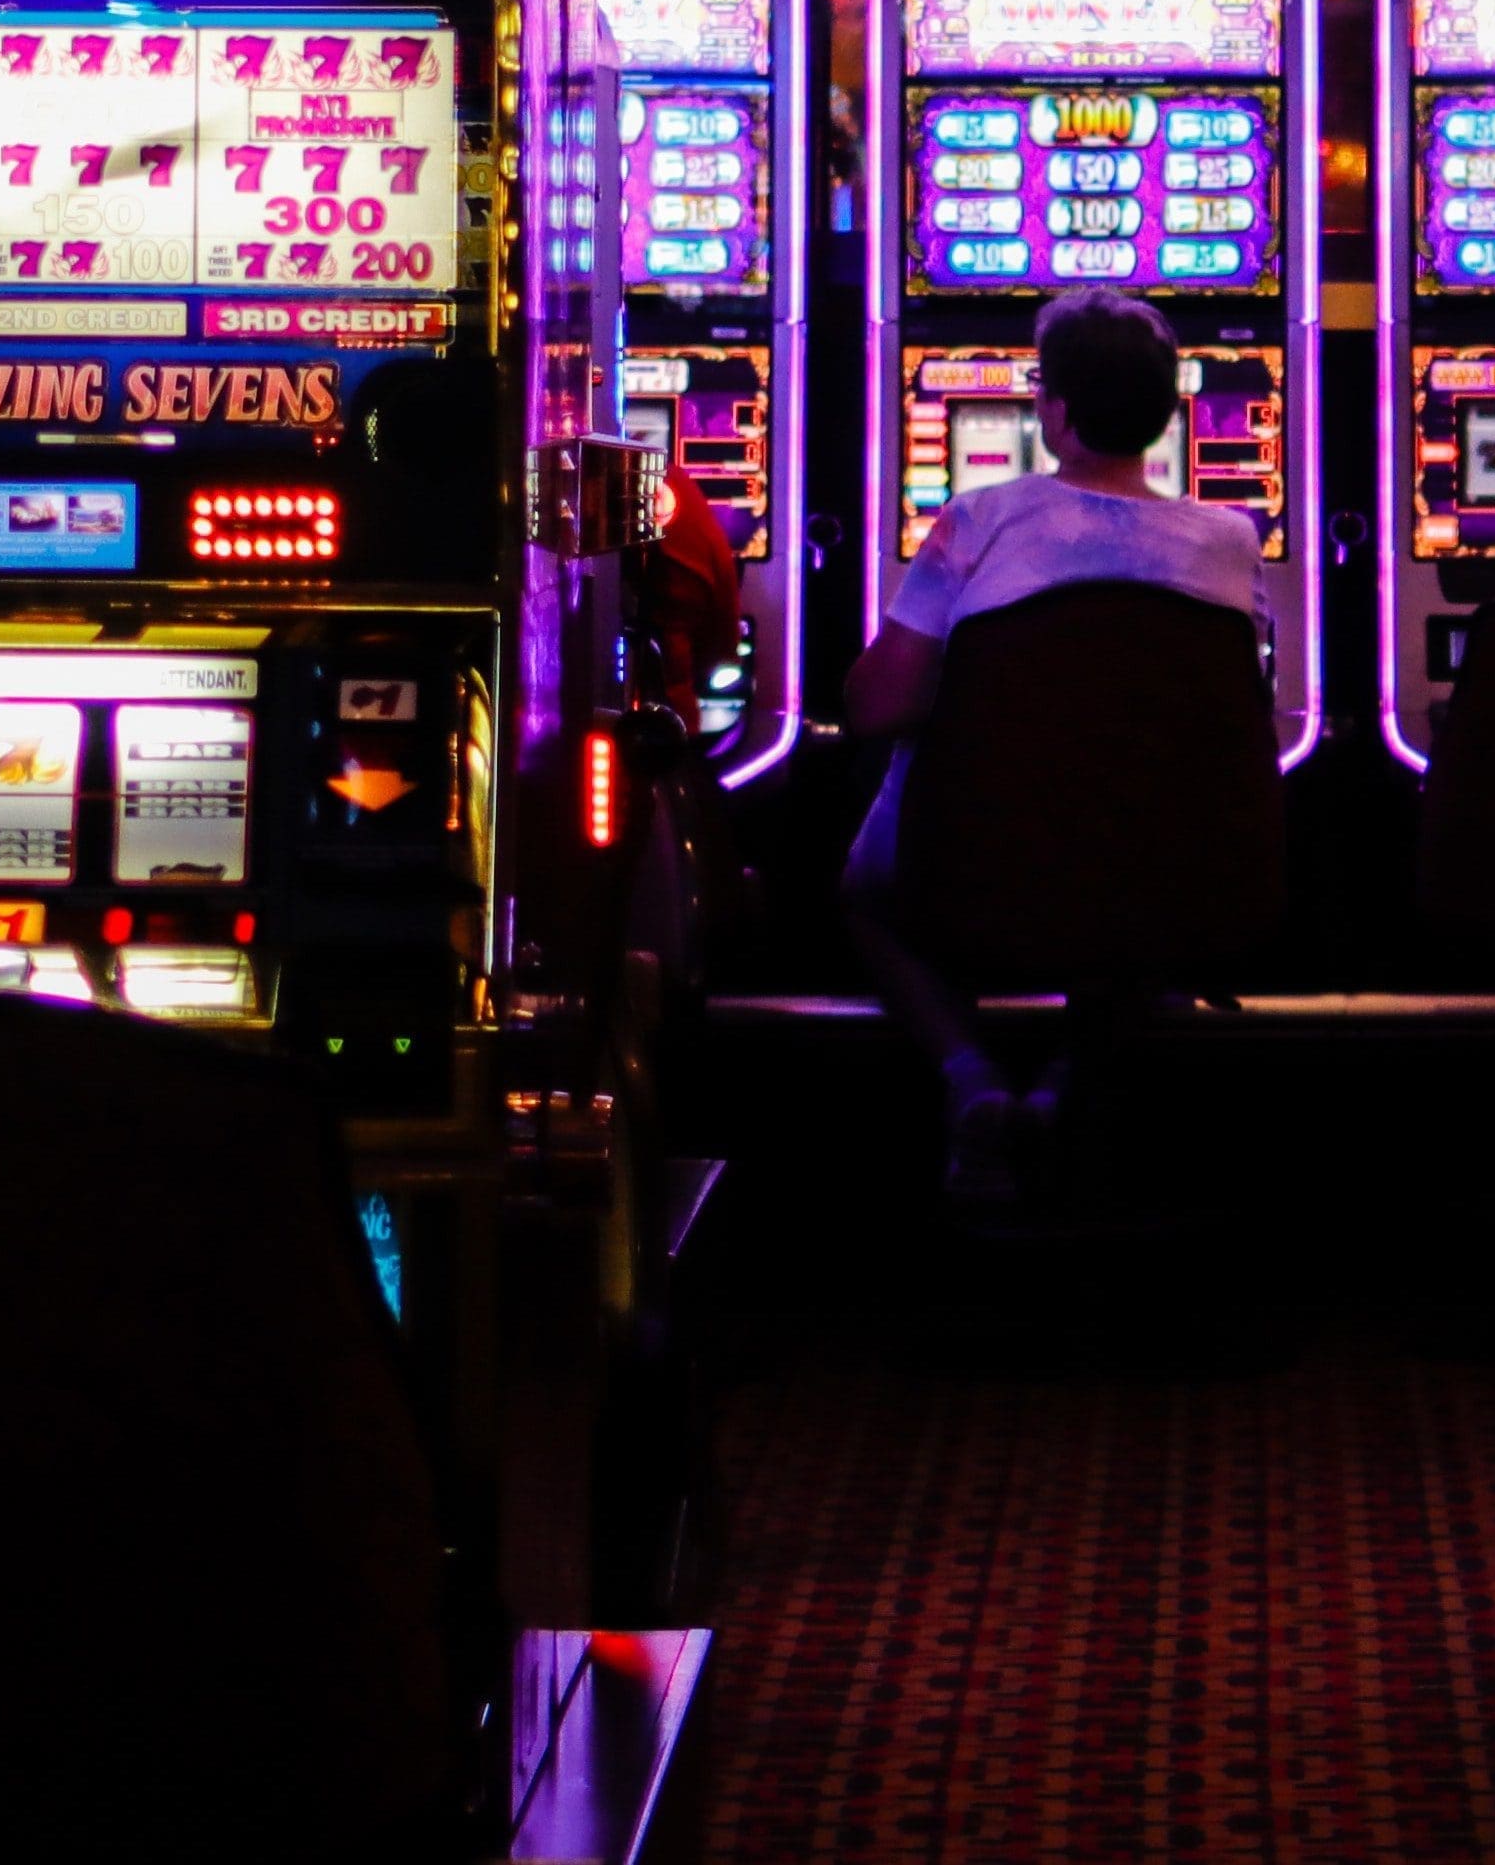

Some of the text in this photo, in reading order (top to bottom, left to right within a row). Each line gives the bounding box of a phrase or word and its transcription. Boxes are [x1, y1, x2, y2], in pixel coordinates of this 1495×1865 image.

[1054, 96, 1133, 137] 1000
[0, 143, 182, 187] 7 7 7
[224, 145, 430, 194] 7 7 7
[1076, 154, 1112, 186] 50
[1198, 160, 1231, 184] 25
[32, 192, 146, 236] 150
[263, 196, 388, 236] 300
[958, 202, 990, 228] 25
[1072, 200, 1119, 230] 100
[1200, 202, 1229, 229] 15
[9, 240, 48, 277] 7
[113, 239, 189, 281] 100
[236, 242, 275, 279] 7
[351, 241, 434, 281] 200
[973, 243, 1001, 266] 10
[1077, 241, 1114, 268] 40
[64, 308, 180, 332] CREDIT
[218, 308, 432, 333] 3RD CREDIT
[124, 363, 336, 424] SEVENS
[138, 744, 233, 758] BAR
